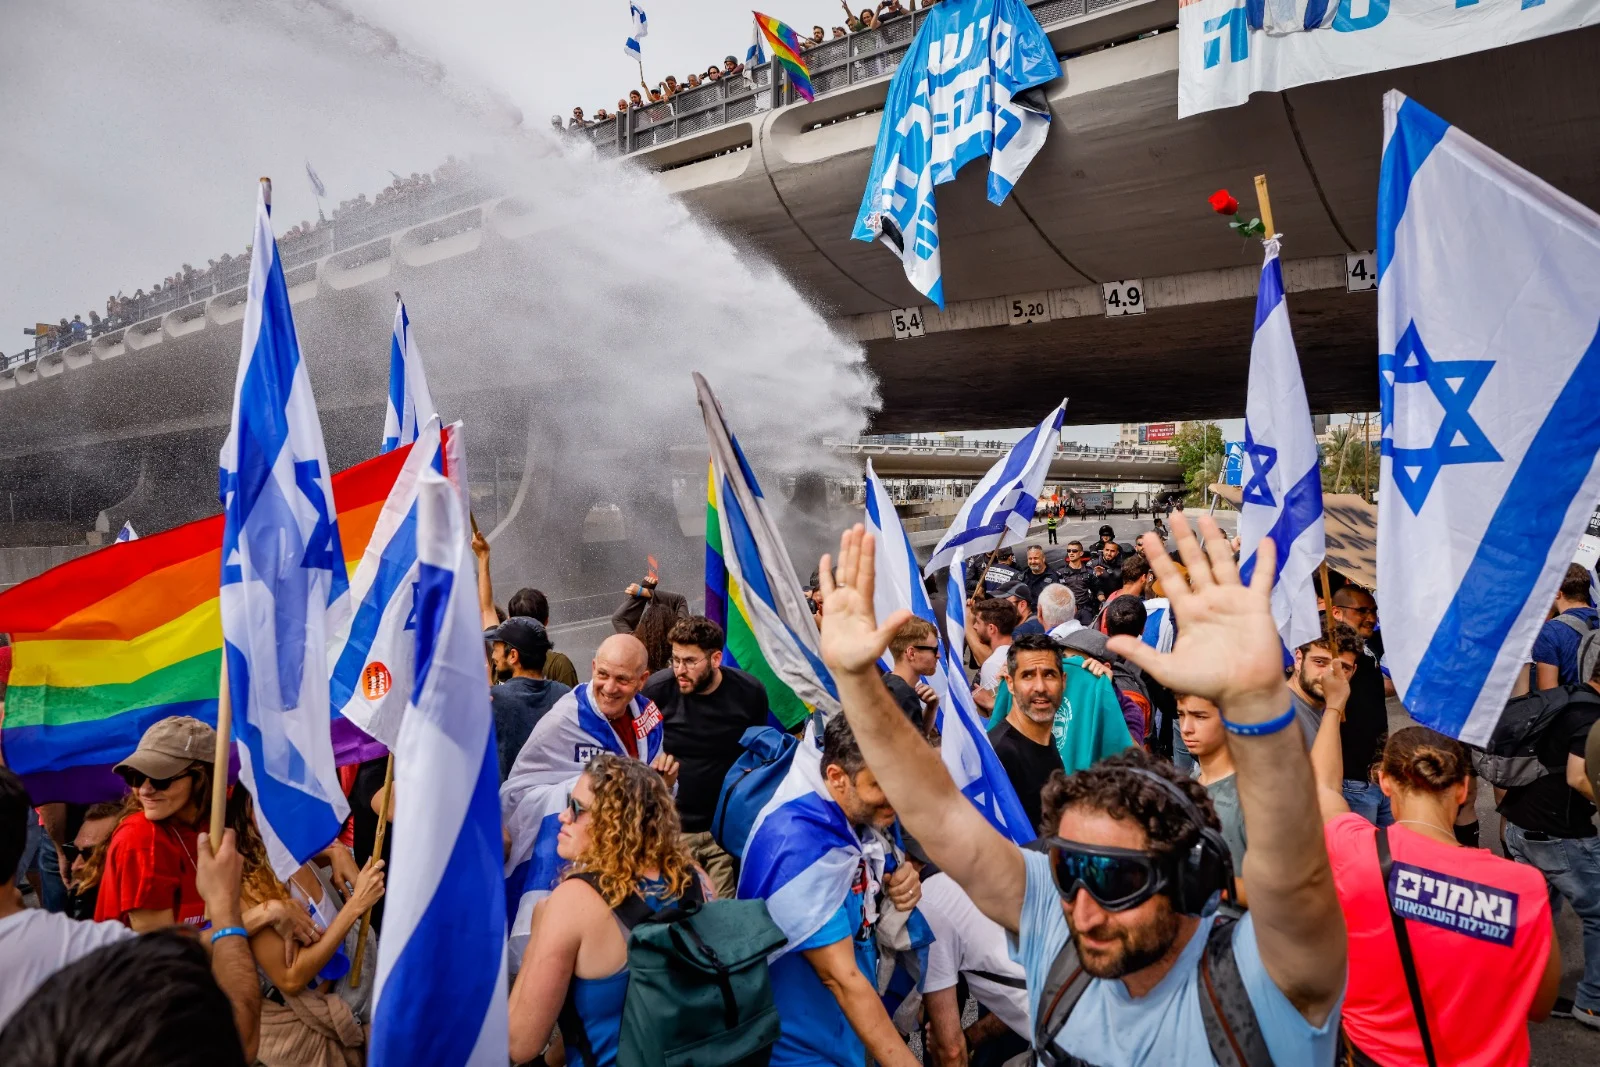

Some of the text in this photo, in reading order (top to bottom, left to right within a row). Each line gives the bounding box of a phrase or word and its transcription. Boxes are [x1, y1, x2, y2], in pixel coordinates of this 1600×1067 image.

[1108, 286, 1141, 308] 4.9
[1012, 300, 1044, 318] 5.20
[895, 312, 920, 333] 5.4
[1395, 869, 1513, 926] נאמנים
[1394, 897, 1510, 940] למגילת העצמאות
